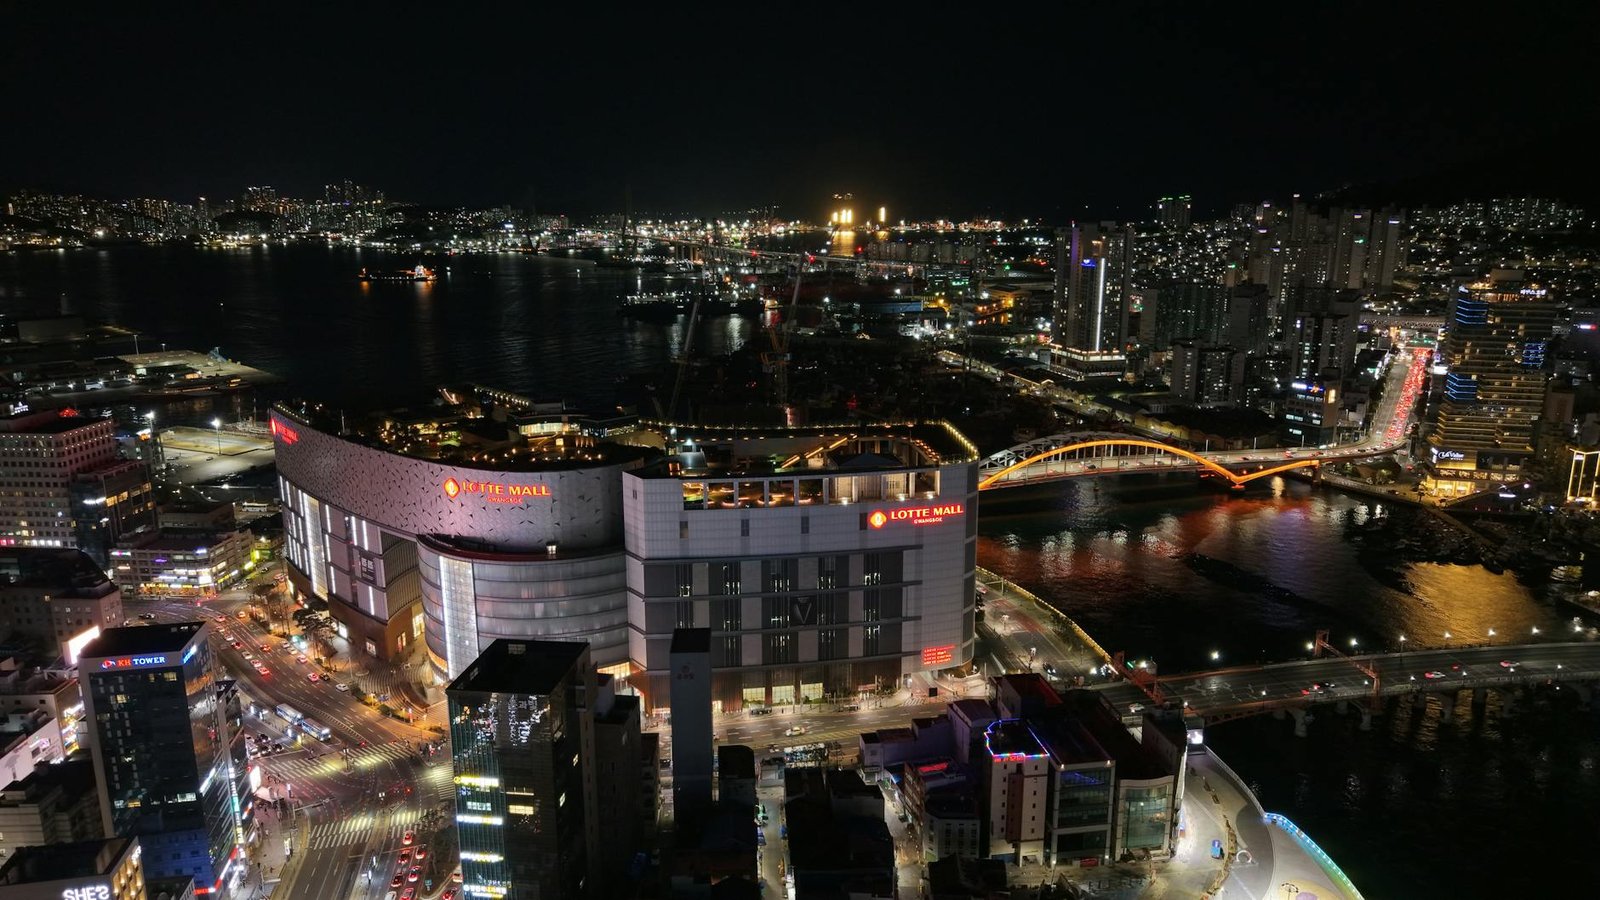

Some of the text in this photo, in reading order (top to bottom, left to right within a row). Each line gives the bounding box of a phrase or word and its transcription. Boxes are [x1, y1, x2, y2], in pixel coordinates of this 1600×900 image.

[462, 481, 551, 496] LOTTE MALL
[891, 504, 964, 520] LOTTE MALL
[117, 656, 166, 667] KH TOWER
